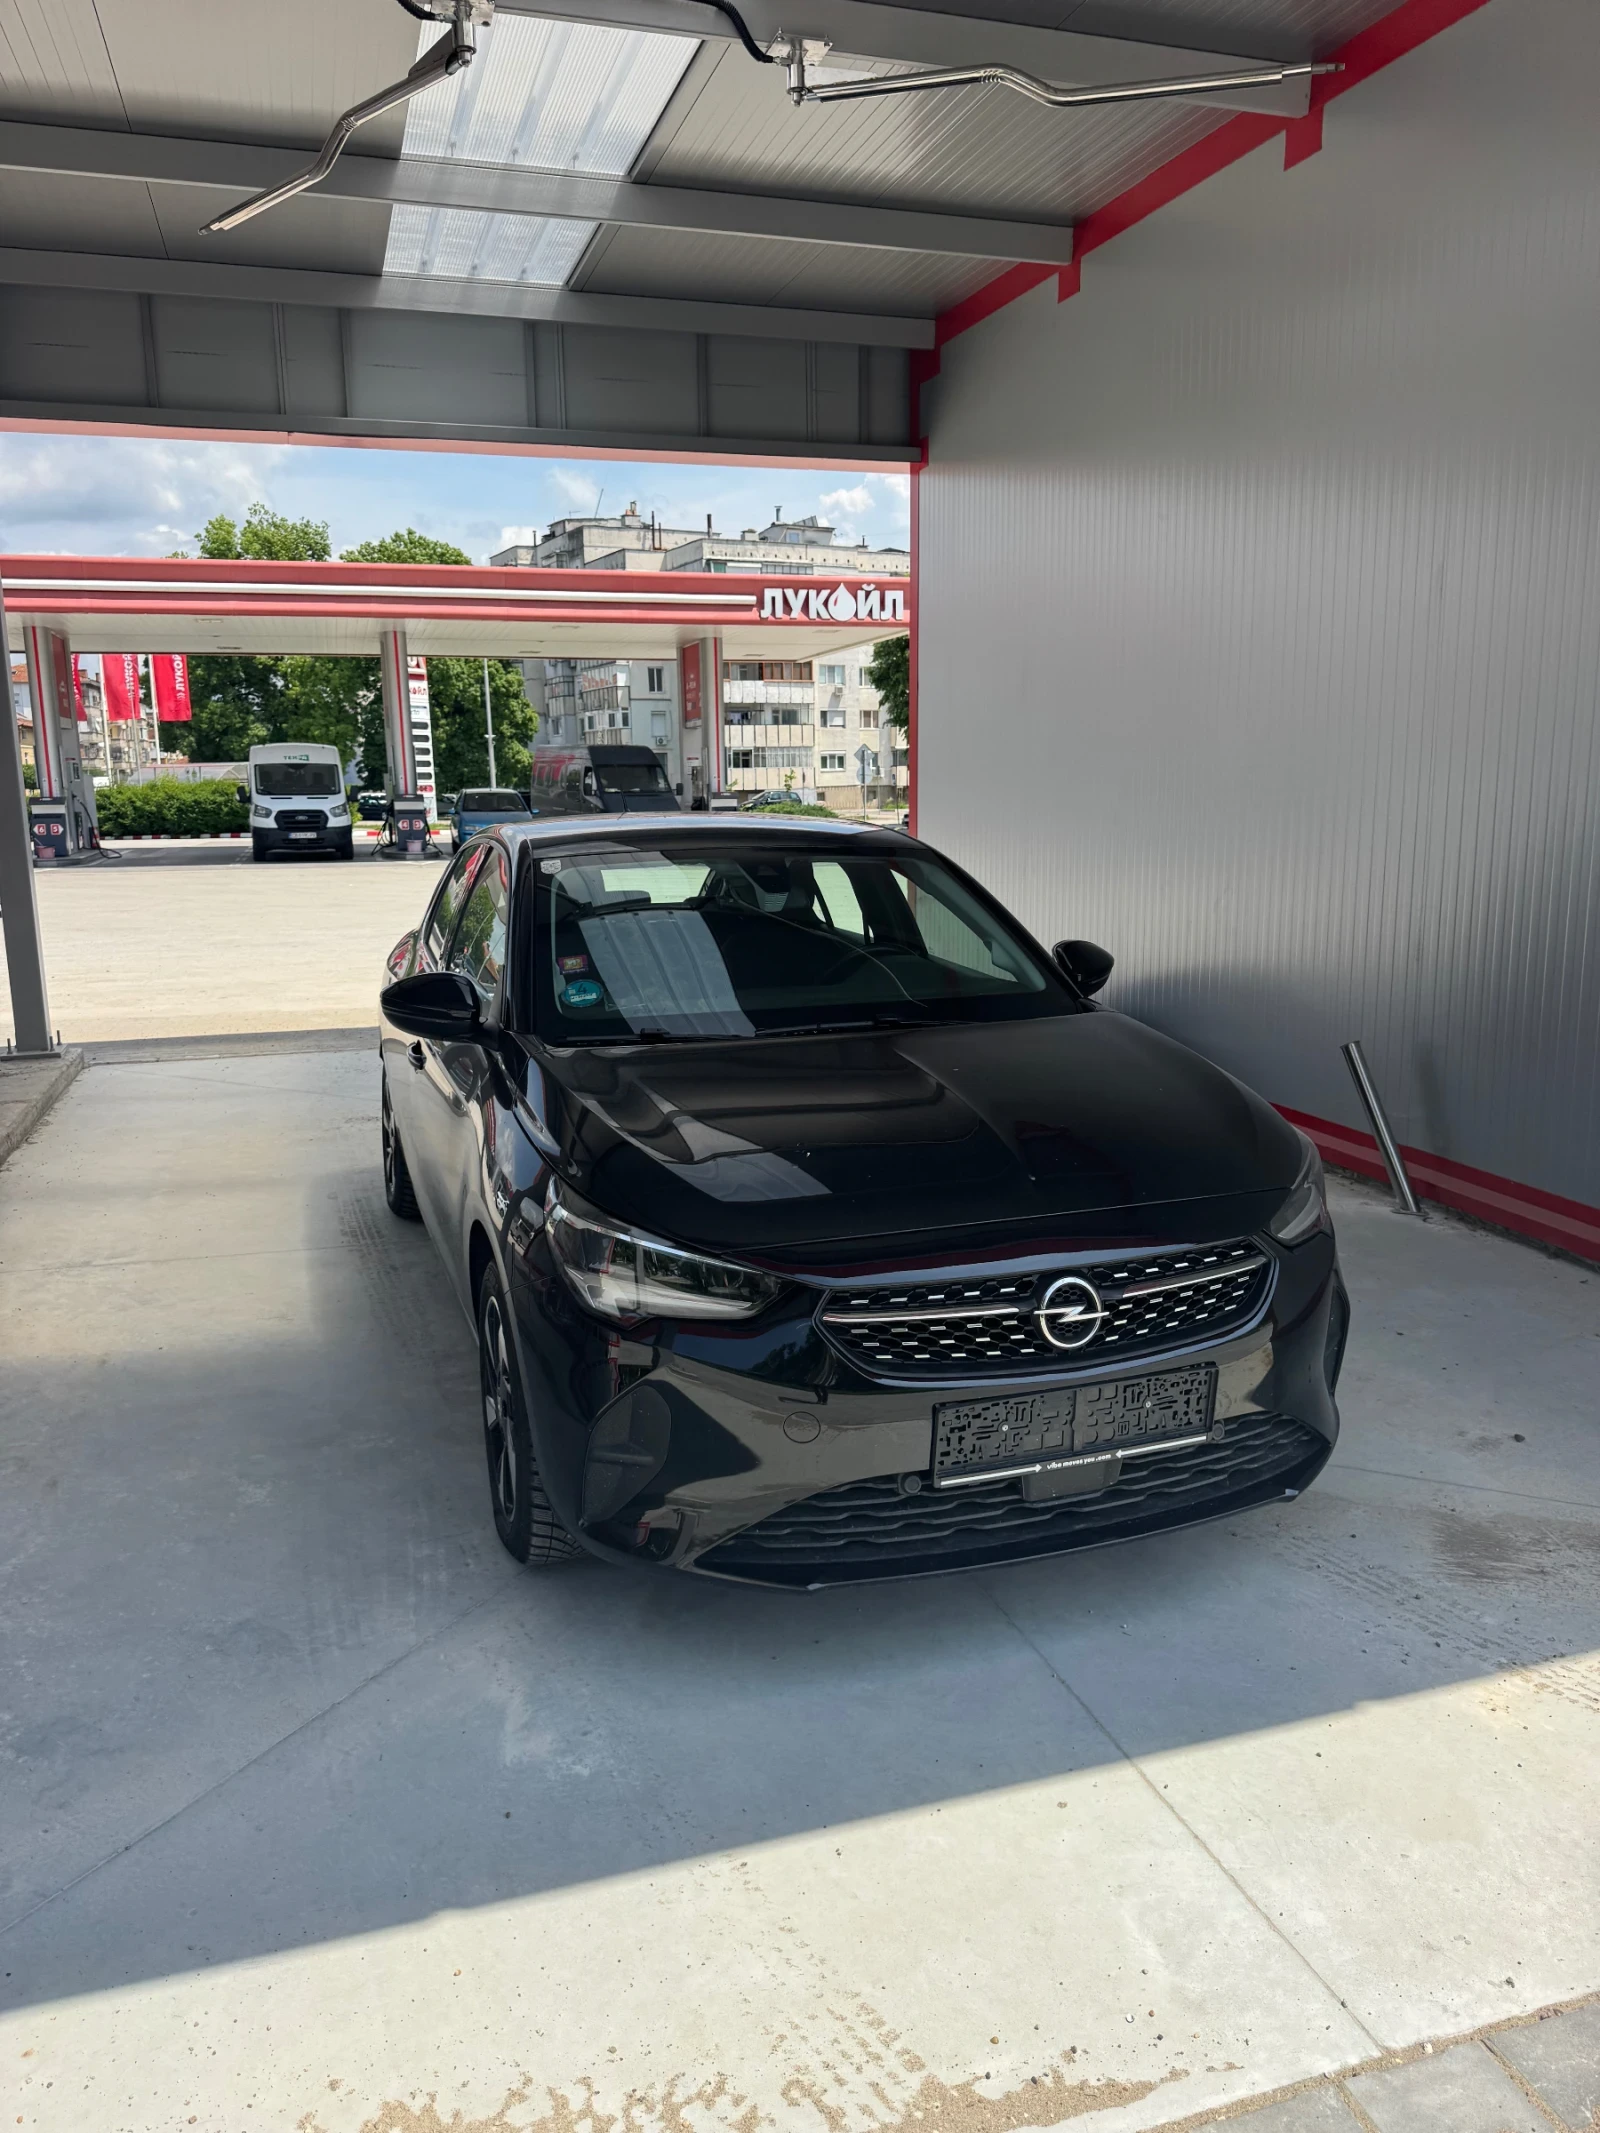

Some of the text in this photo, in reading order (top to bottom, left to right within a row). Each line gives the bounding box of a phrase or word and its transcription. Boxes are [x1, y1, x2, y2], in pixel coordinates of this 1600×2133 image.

[760, 583, 904, 621] ЛУКОЙЛ
[577, 982, 587, 993] 4
[1046, 1461, 1062, 1470] vibe
[1063, 1459, 1083, 1467] moves
